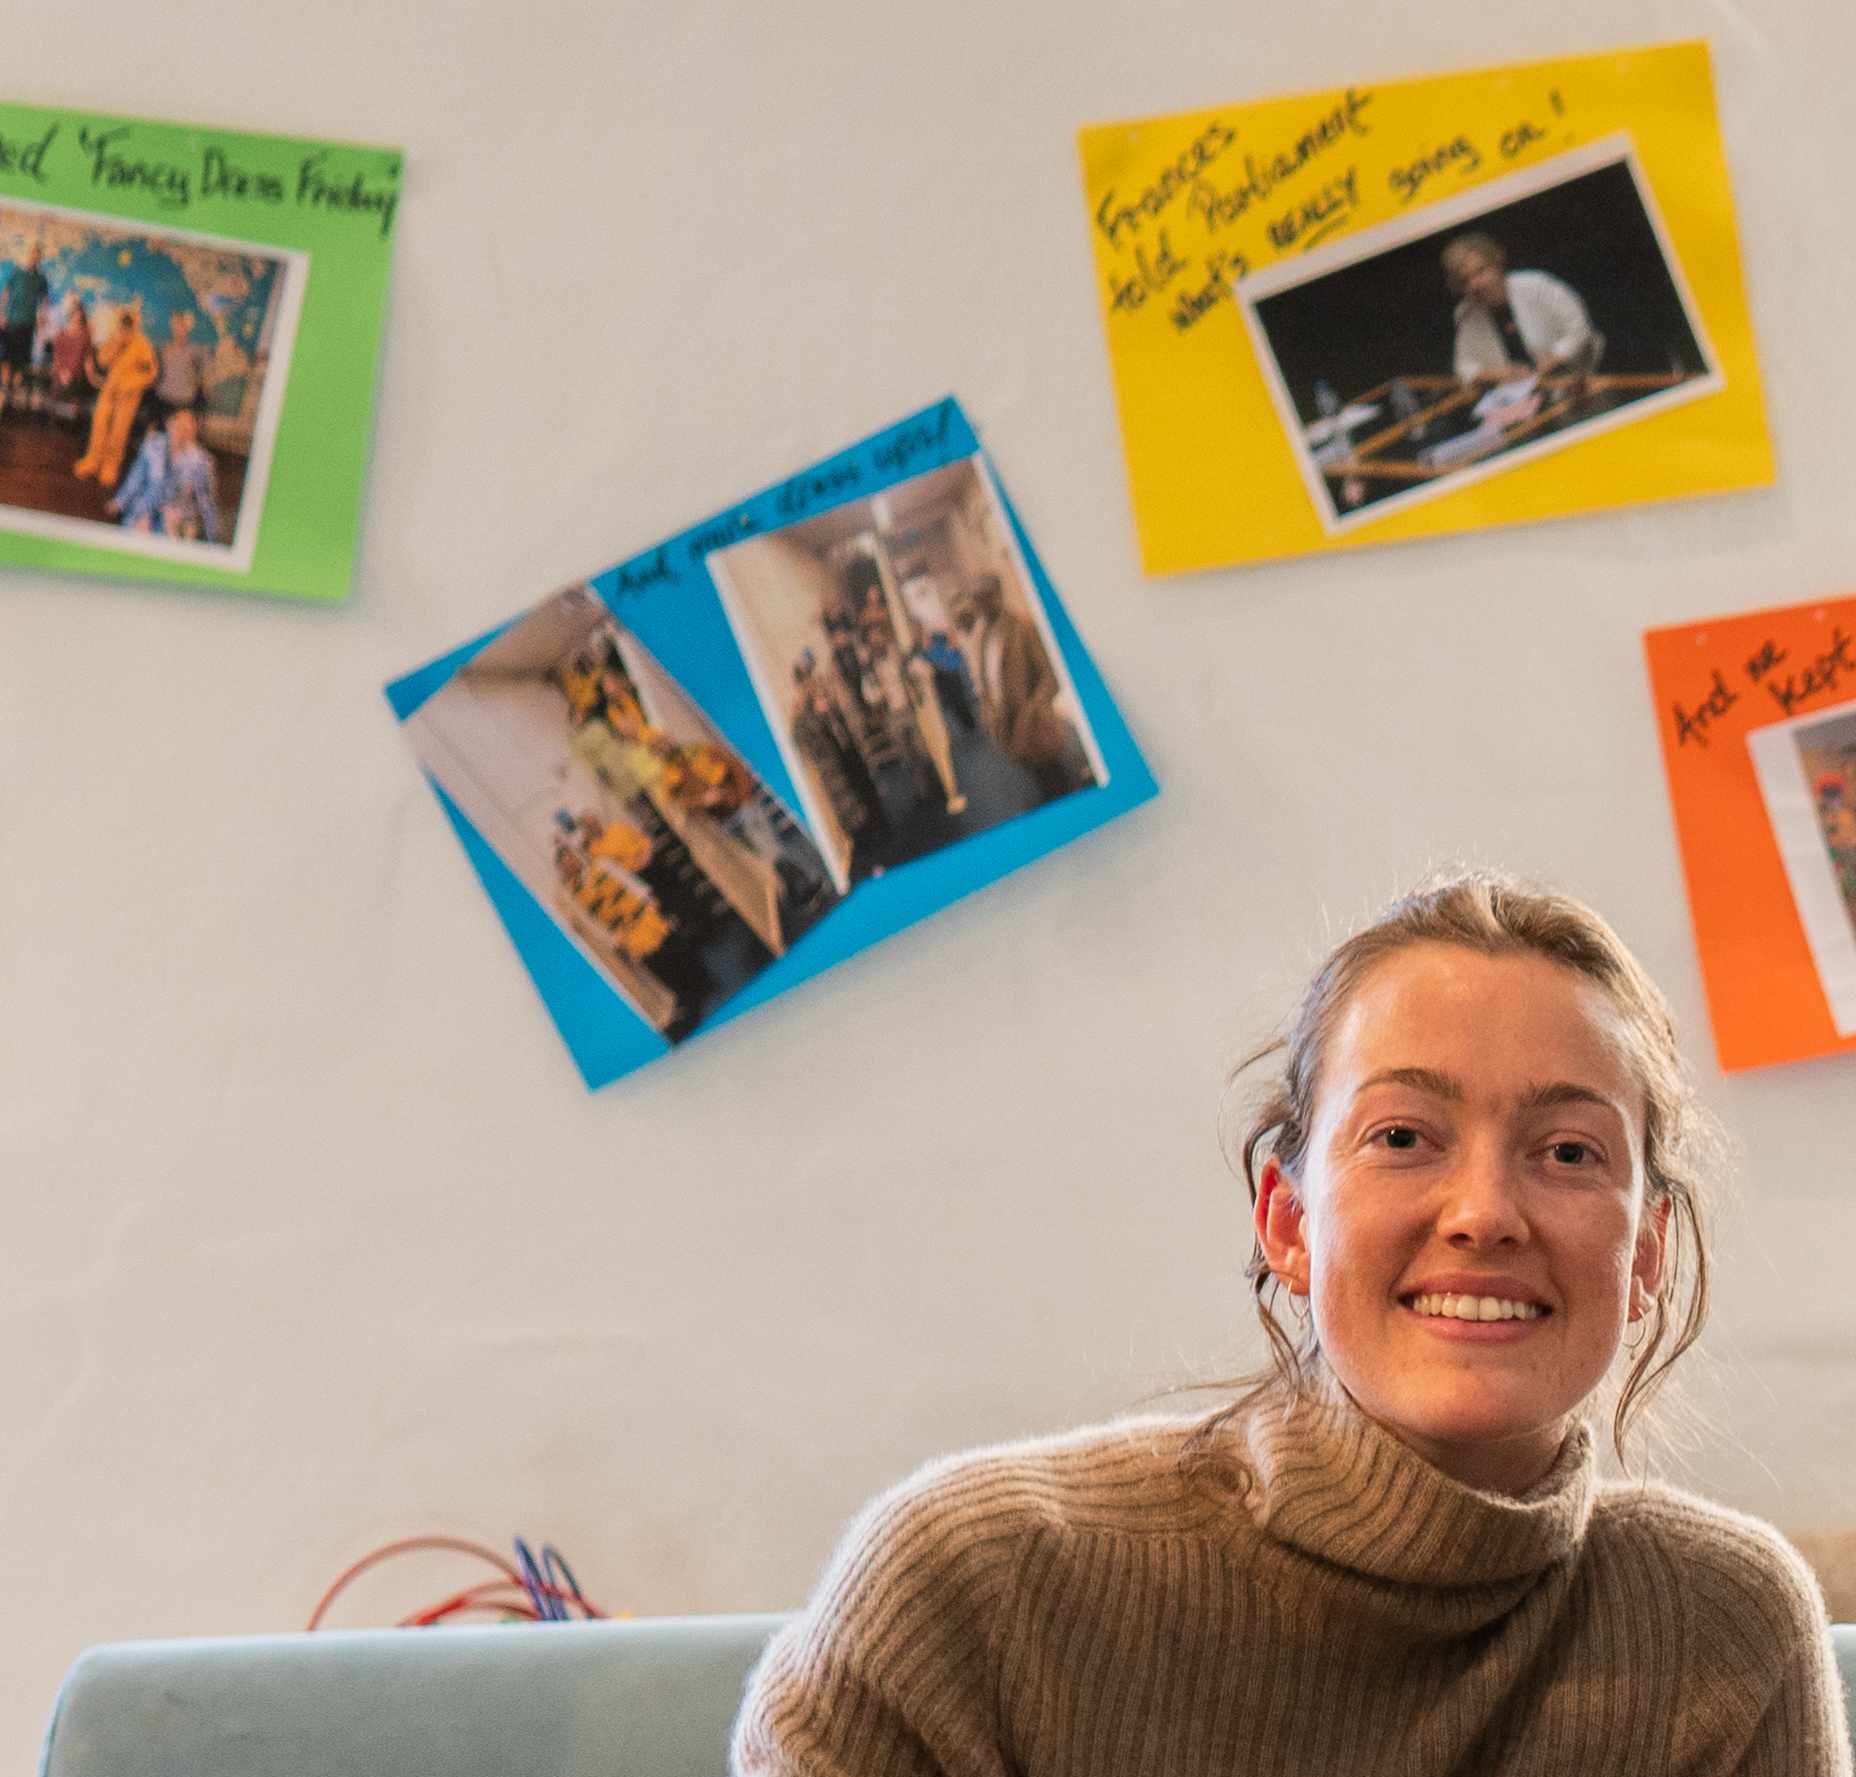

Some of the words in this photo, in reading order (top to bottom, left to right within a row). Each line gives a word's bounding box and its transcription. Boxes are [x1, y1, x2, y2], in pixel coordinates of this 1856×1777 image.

[1097, 121, 1237, 254] Frances
[1110, 228, 1189, 316] told
[1186, 89, 1373, 235] Parliament
[1388, 135, 1482, 205] going
[1671, 668, 1740, 748] And
